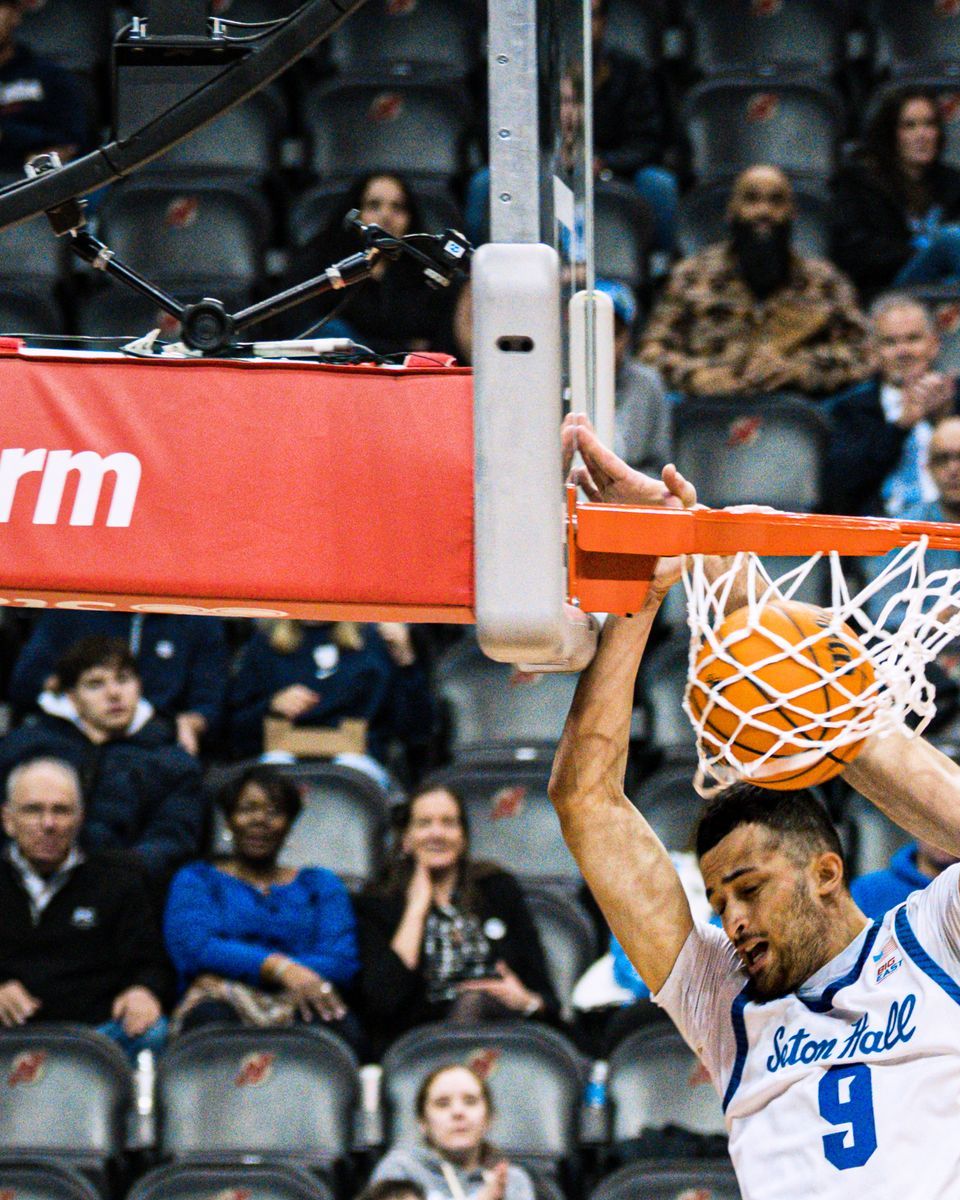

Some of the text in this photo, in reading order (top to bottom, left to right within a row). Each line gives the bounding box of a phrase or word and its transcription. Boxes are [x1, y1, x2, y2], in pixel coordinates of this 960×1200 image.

[0, 447, 142, 528] rm
[876, 958, 904, 983] EAST
[877, 956, 896, 976] BIG
[766, 993, 917, 1073] Seton Hall
[818, 1062, 878, 1171] 9
